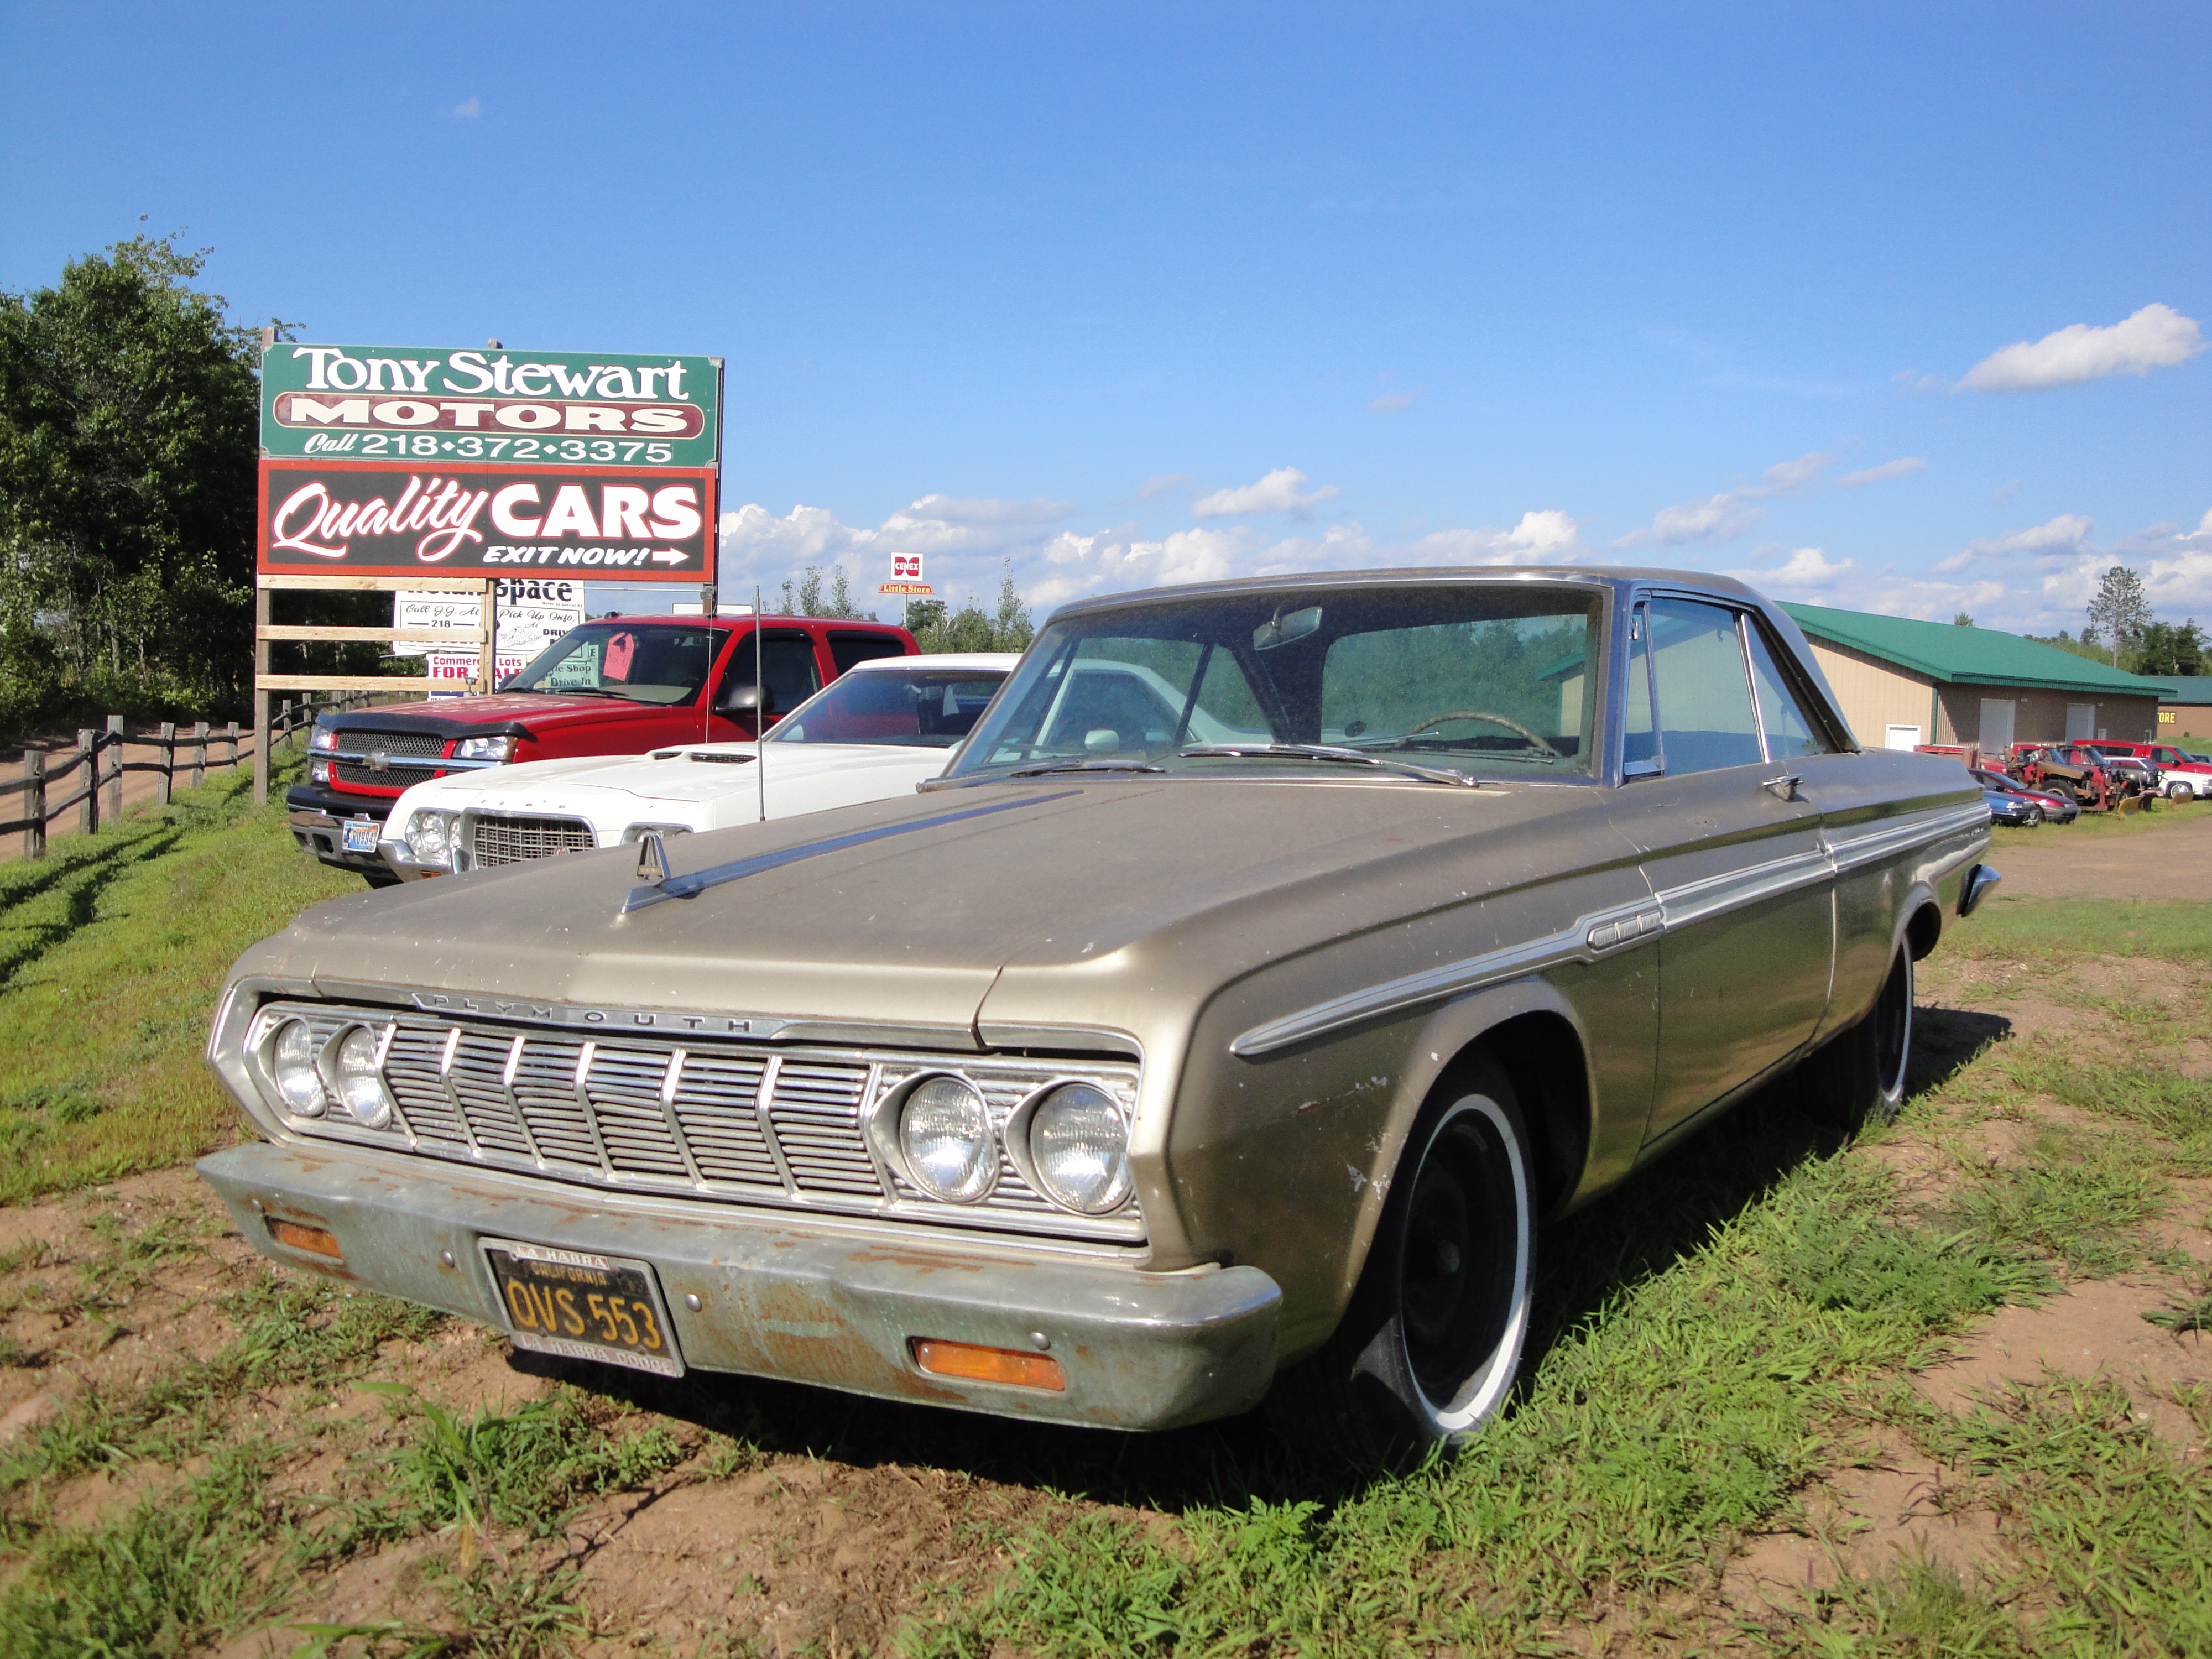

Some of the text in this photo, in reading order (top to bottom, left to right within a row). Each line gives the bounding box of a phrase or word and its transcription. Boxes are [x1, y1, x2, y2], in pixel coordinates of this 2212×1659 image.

[292, 347, 690, 400] Tony Stewart
[290, 397, 687, 432] MOTORS
[304, 432, 359, 454] Call
[273, 475, 702, 561] Quality CARS
[482, 545, 650, 566] EXIT NOW!
[895, 562, 919, 570] CENEX
[883, 584, 930, 593] Little Store
[406, 604, 431, 613] Call
[499, 609, 524, 619] Pick
[526, 609, 545, 621] Up
[431, 619, 451, 628] 218
[499, 657, 522, 667] Lots
[566, 665, 591, 674] Shop
[432, 666, 469, 679] FOR
[550, 677, 591, 687] Drive In
[2157, 712, 2176, 723] ORE
[433, 994, 752, 1034] PLYMOUTH
[516, 1245, 608, 1269] LA HABRA
[530, 1261, 608, 1286] CALIFORNIA
[507, 1280, 662, 1350] QVS 553
[551, 1340, 610, 1361] HABRA
[615, 1352, 677, 1376] DODGE
